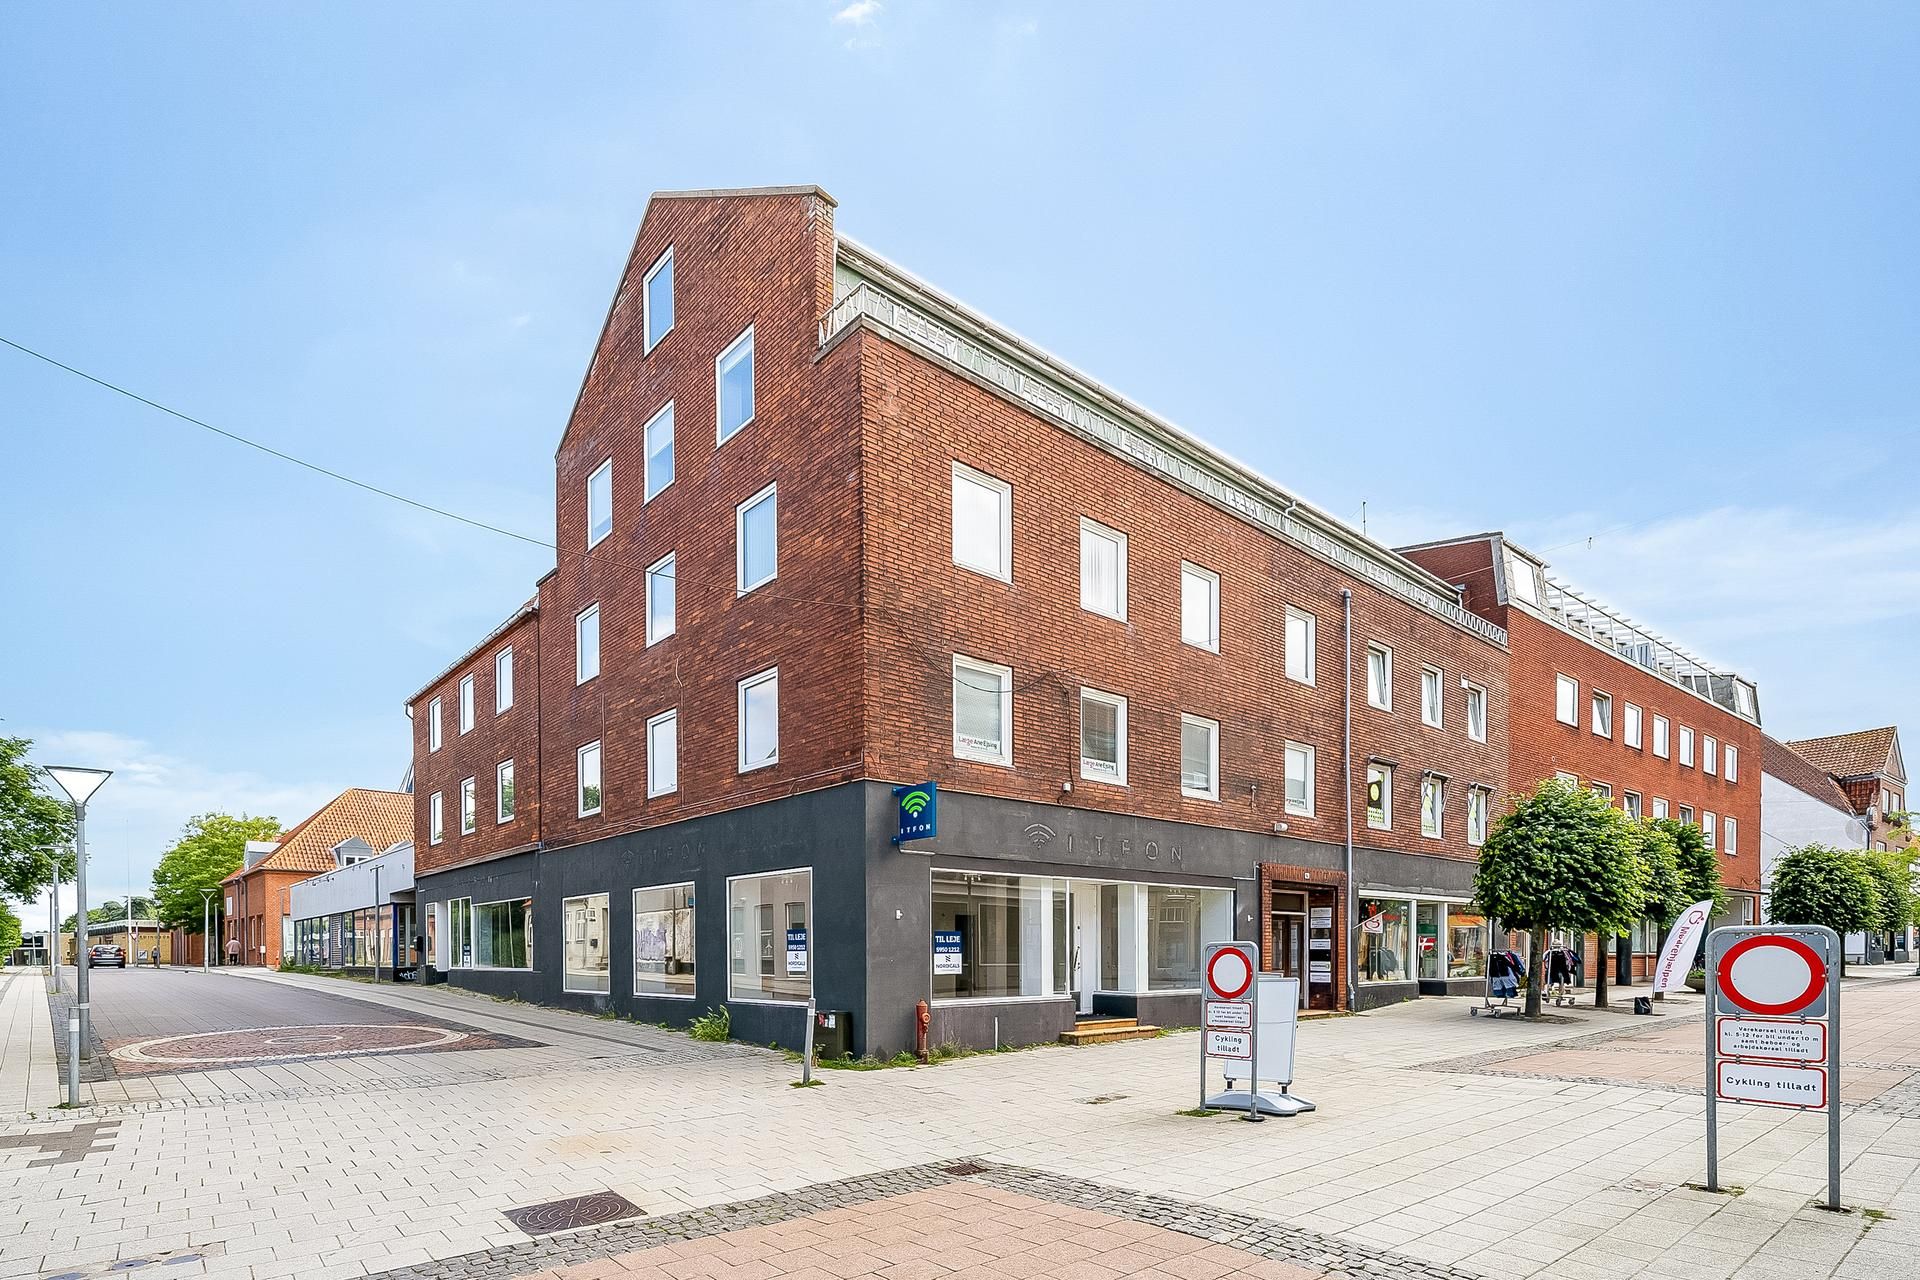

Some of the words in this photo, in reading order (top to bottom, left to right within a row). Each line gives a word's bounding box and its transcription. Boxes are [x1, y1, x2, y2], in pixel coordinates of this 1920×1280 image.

[900, 823, 931, 834] ITFON
[1067, 834, 1182, 862] ITFON
[935, 935, 945, 943] TIL
[946, 935, 960, 943] LEJE
[1660, 926, 1690, 988] Mødrehjælpen
[1215, 1034, 1242, 1044] Cykling
[1217, 1045, 1240, 1053] tilladt
[1726, 1076, 1770, 1088] Cykling
[1777, 1081, 1817, 1092] tilladt
